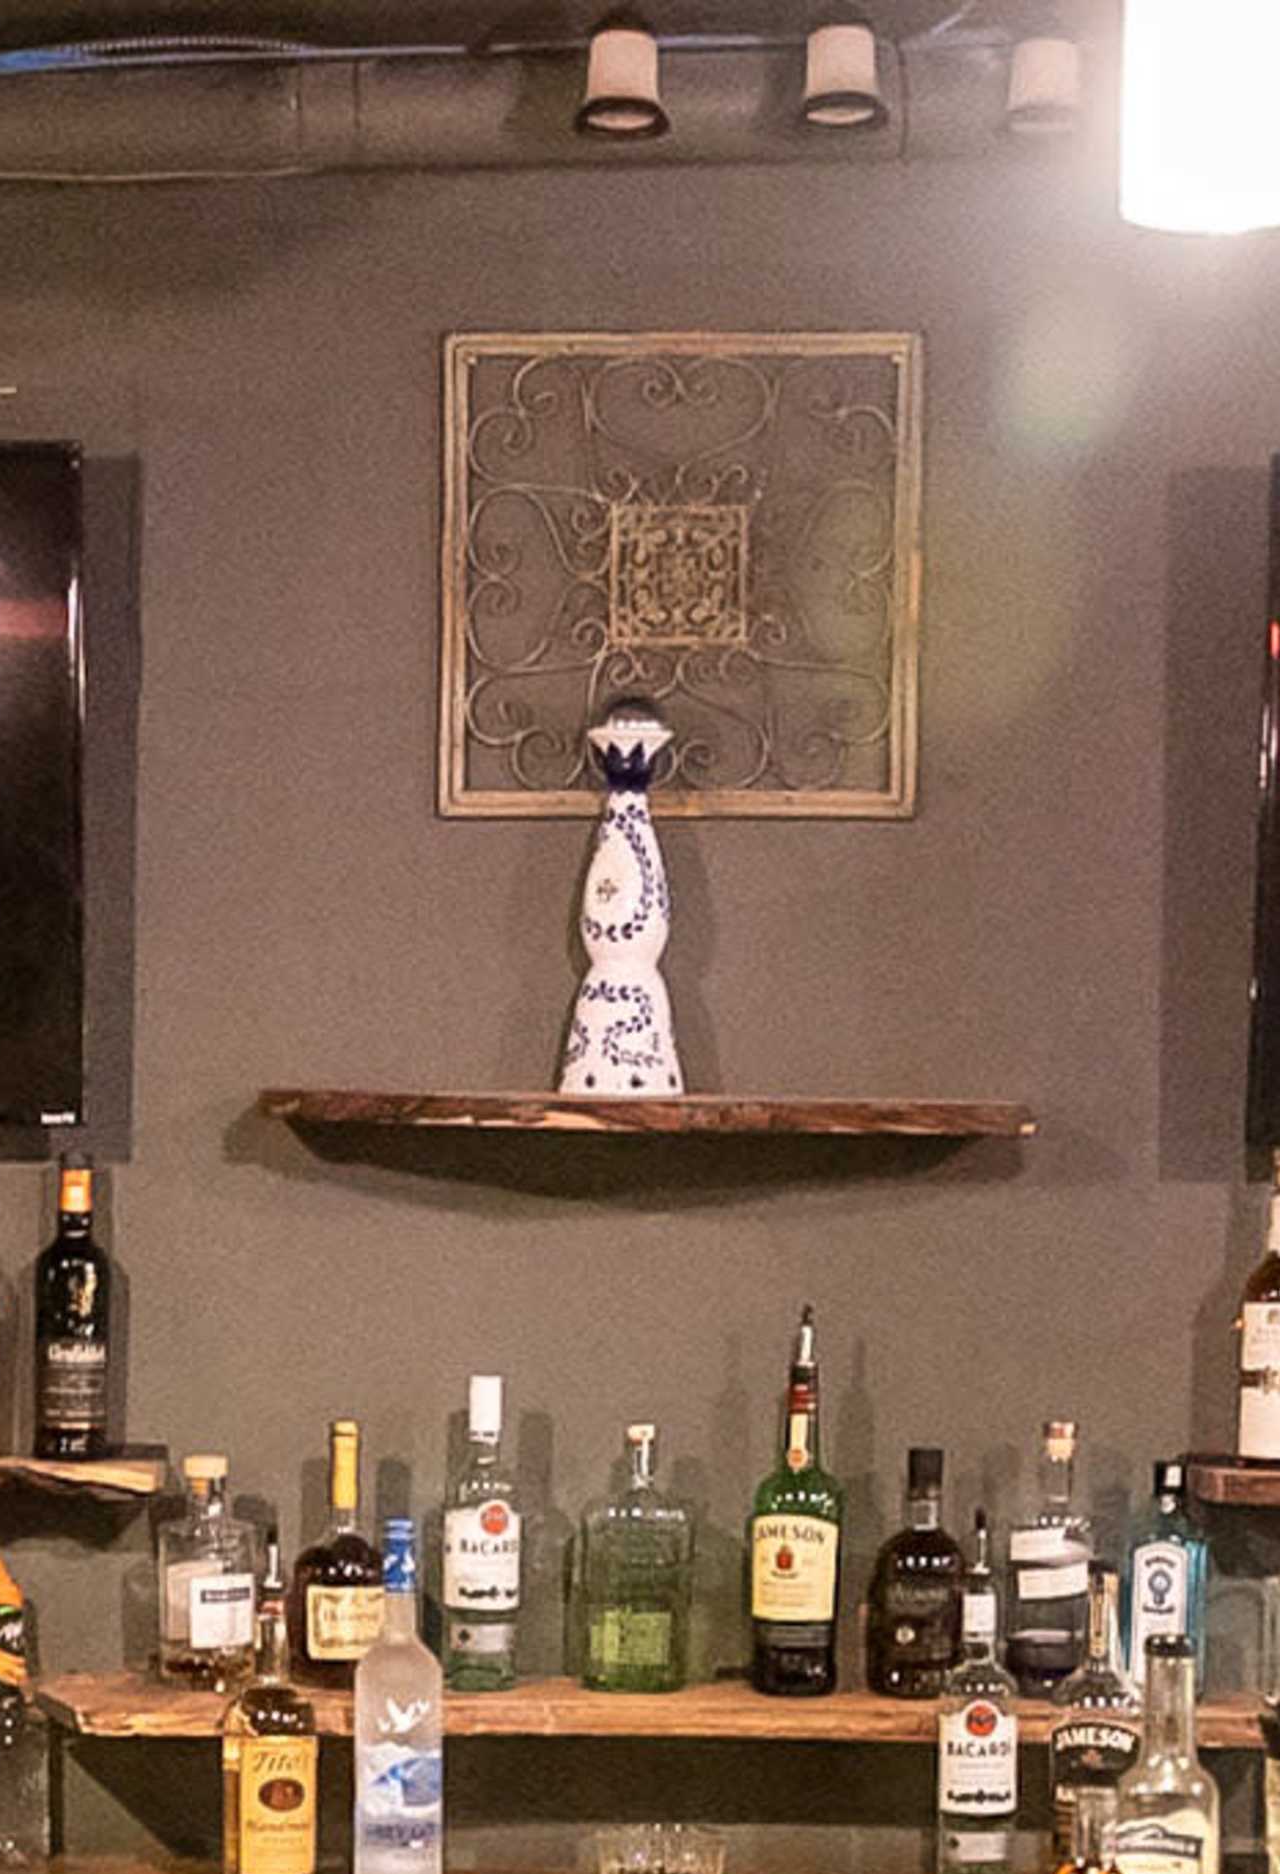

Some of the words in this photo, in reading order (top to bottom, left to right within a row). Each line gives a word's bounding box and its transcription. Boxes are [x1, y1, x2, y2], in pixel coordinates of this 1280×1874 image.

[754, 1524, 825, 1545] JAMESON
[460, 1538, 520, 1556] BACARD
[946, 1740, 1012, 1757] BACARDI
[1056, 1727, 1135, 1753] JAMESON
